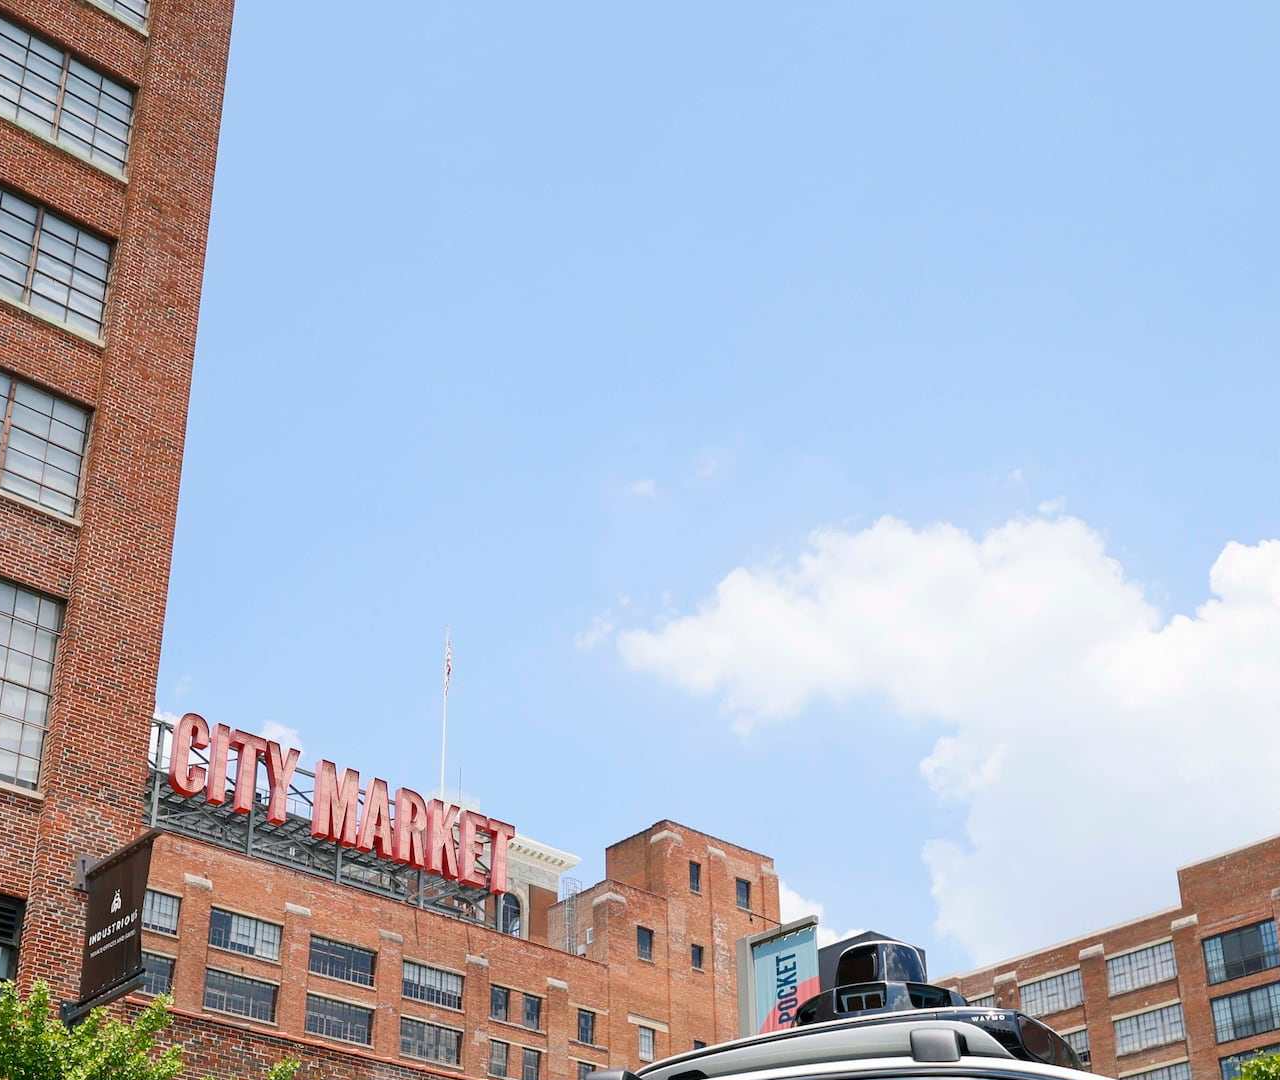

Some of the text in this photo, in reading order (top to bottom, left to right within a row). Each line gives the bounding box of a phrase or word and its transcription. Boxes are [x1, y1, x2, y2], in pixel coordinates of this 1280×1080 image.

[169, 712, 516, 895] CITY MARKET
[89, 909, 138, 946] INDUSTRIOUS
[775, 952, 798, 1025] POCKET
[971, 1014, 1006, 1022] WAYMO
